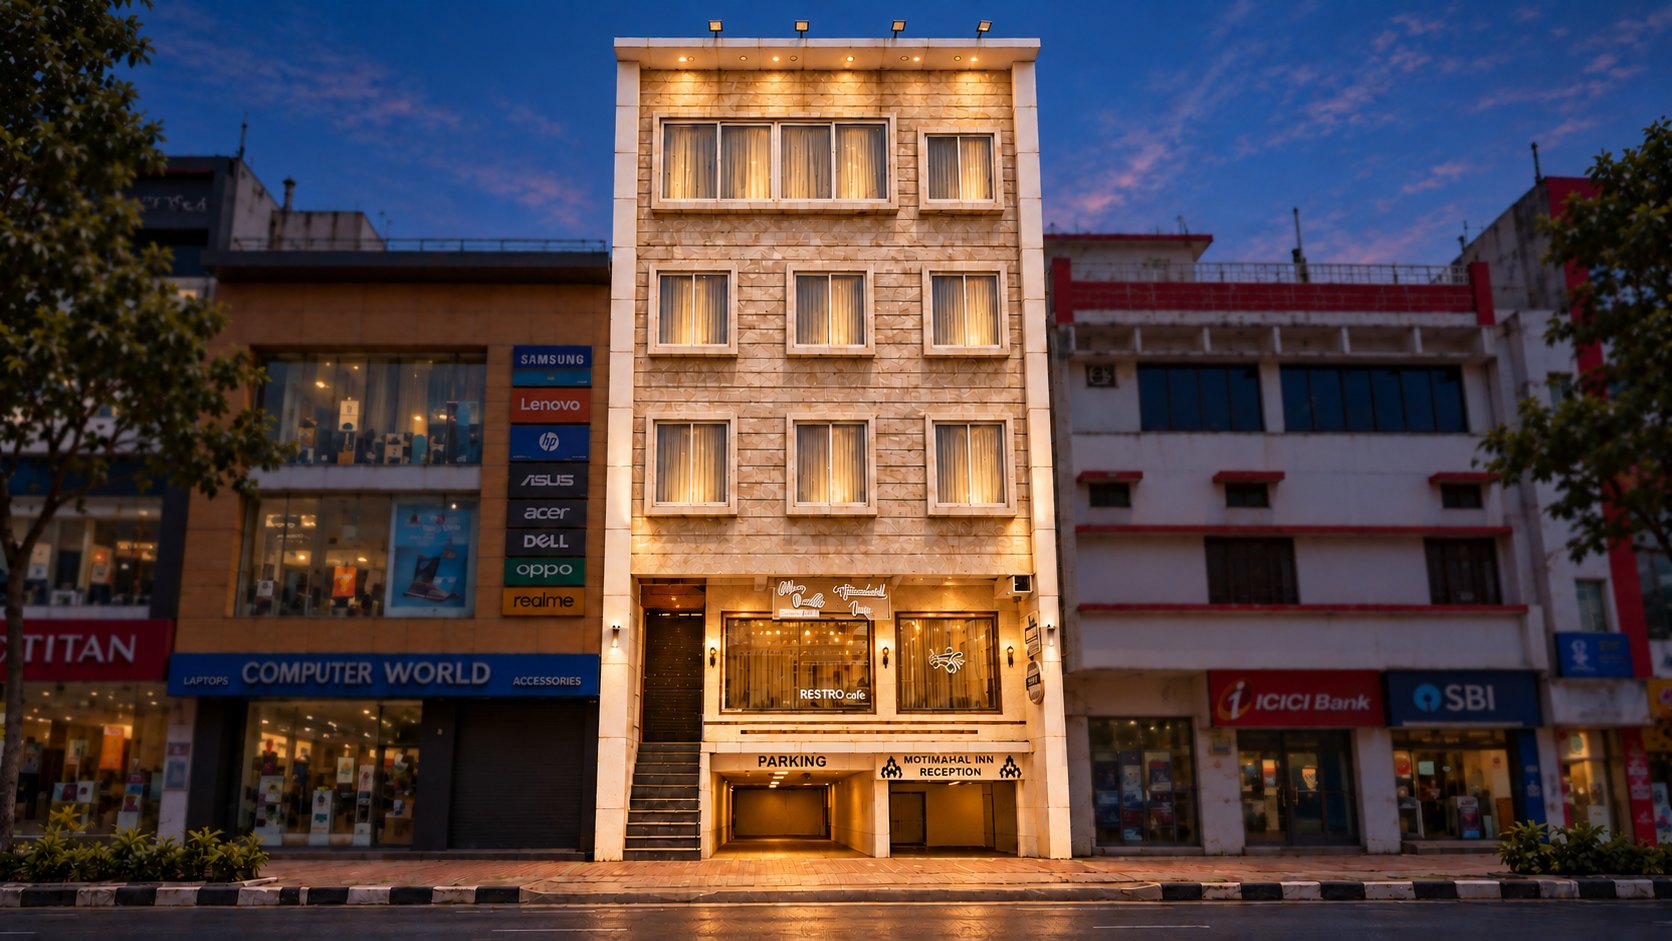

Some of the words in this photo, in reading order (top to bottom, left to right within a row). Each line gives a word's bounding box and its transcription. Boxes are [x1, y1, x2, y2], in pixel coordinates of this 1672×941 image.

[520, 354, 585, 365] SAMSUNG
[520, 397, 581, 411] Lenovo
[539, 432, 559, 452] hp
[520, 474, 575, 487] ASUS
[523, 507, 571, 520] acer
[523, 533, 569, 549] DELL
[516, 564, 573, 578] oppo
[513, 592, 574, 608] realme
[22, 633, 137, 664] TITAN
[183, 676, 229, 686] LAPTOPS
[241, 660, 374, 685] COMPUTER
[383, 660, 492, 685] WORLD
[512, 676, 582, 686] ACCESSORIES
[799, 689, 845, 700] RESTRO
[845, 689, 866, 700] cafe
[1255, 692, 1310, 711] ICICI
[1314, 693, 1370, 711] Bank
[1444, 683, 1496, 712] SBI
[758, 755, 827, 768] PARKING
[903, 755, 971, 764] MOTIMAHAL
[975, 755, 994, 764] INN
[919, 767, 981, 777] RECEPTION
